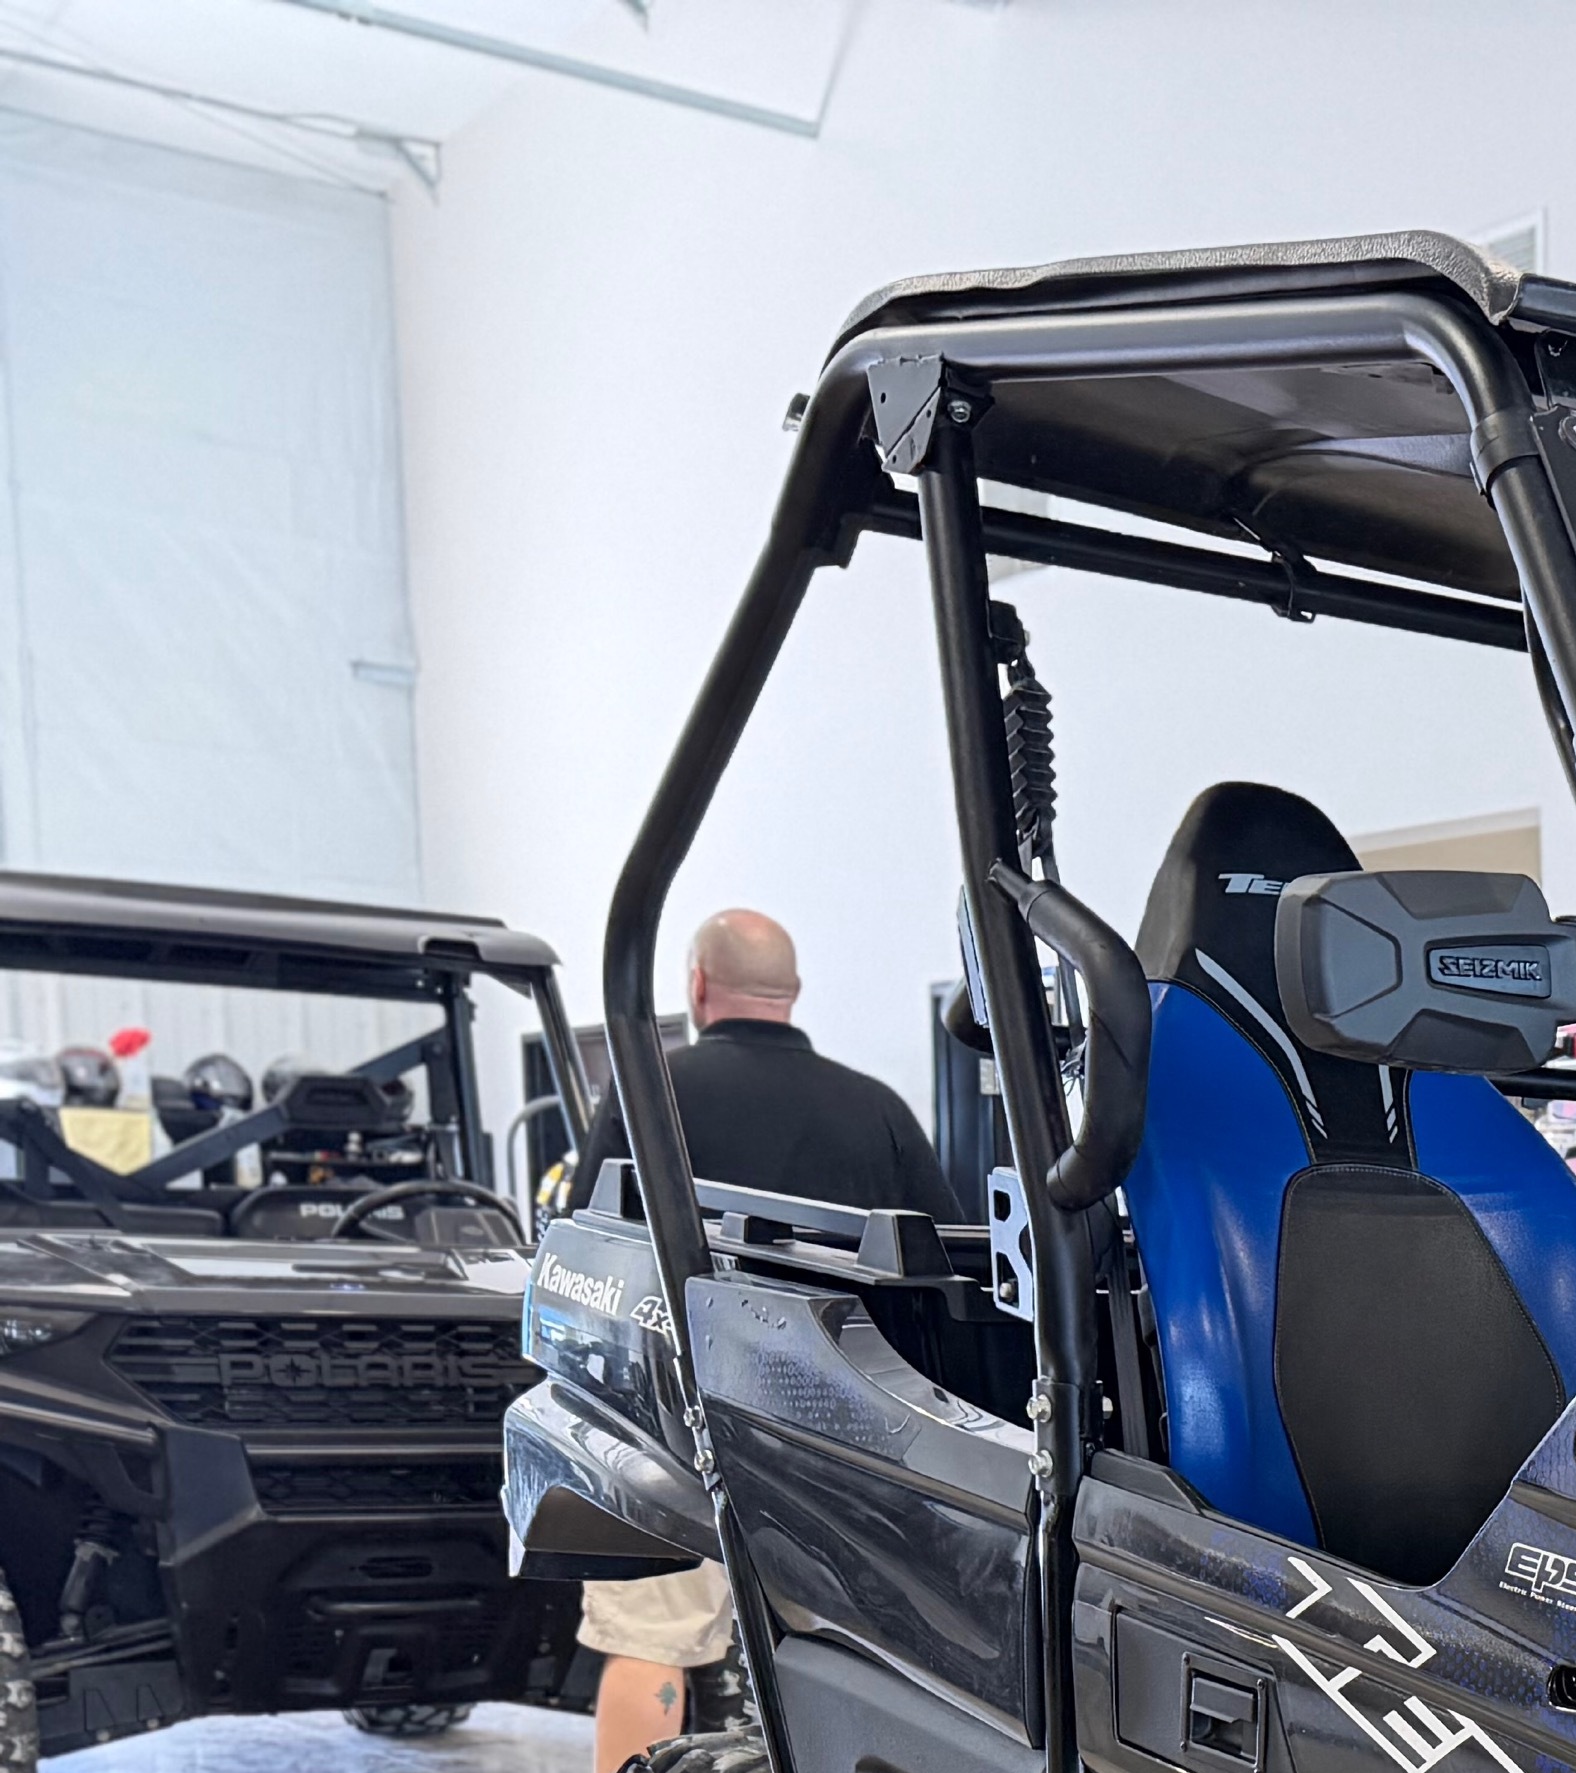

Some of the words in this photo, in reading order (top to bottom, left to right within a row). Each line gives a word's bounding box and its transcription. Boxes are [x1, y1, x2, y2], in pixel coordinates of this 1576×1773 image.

[1438, 954, 1542, 983] SEIZMIK
[537, 1252, 623, 1315] Kawasaki
[630, 1296, 676, 1335] 4x
[219, 1354, 503, 1389] POLARIS
[1499, 1580, 1528, 1596] Electric
[1530, 1591, 1553, 1604] Power
